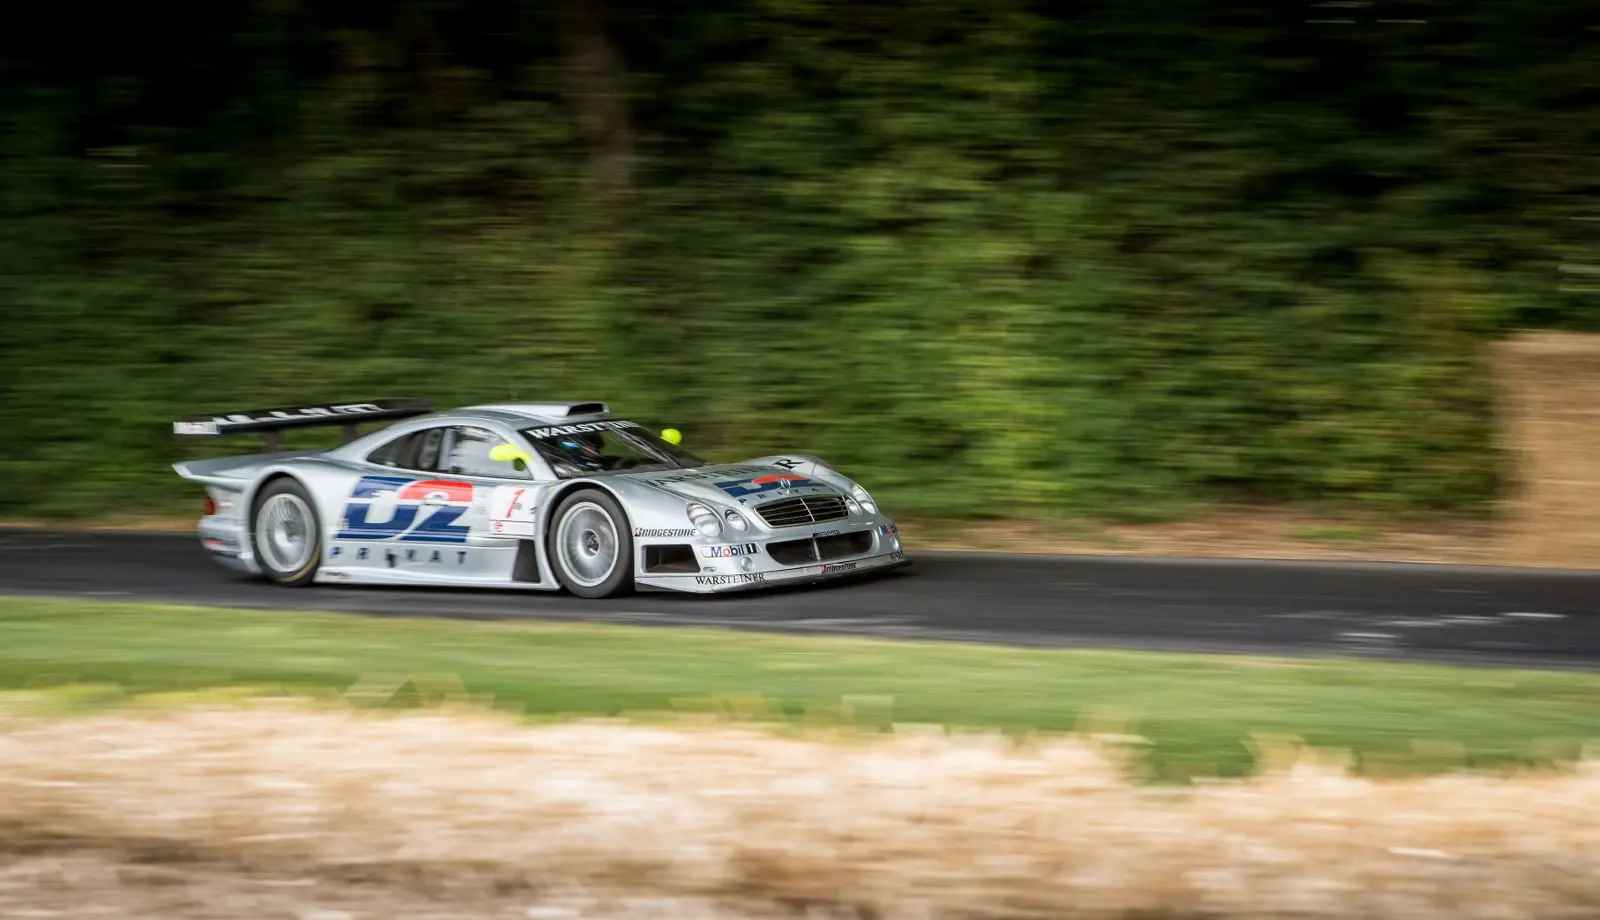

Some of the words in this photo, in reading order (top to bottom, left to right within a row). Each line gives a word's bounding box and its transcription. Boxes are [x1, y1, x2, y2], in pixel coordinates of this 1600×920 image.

[634, 527, 696, 537] BRIDGESTONE
[711, 545, 745, 558] Mobil
[747, 543, 757, 554] 1
[695, 572, 766, 585] WARSTEINER
